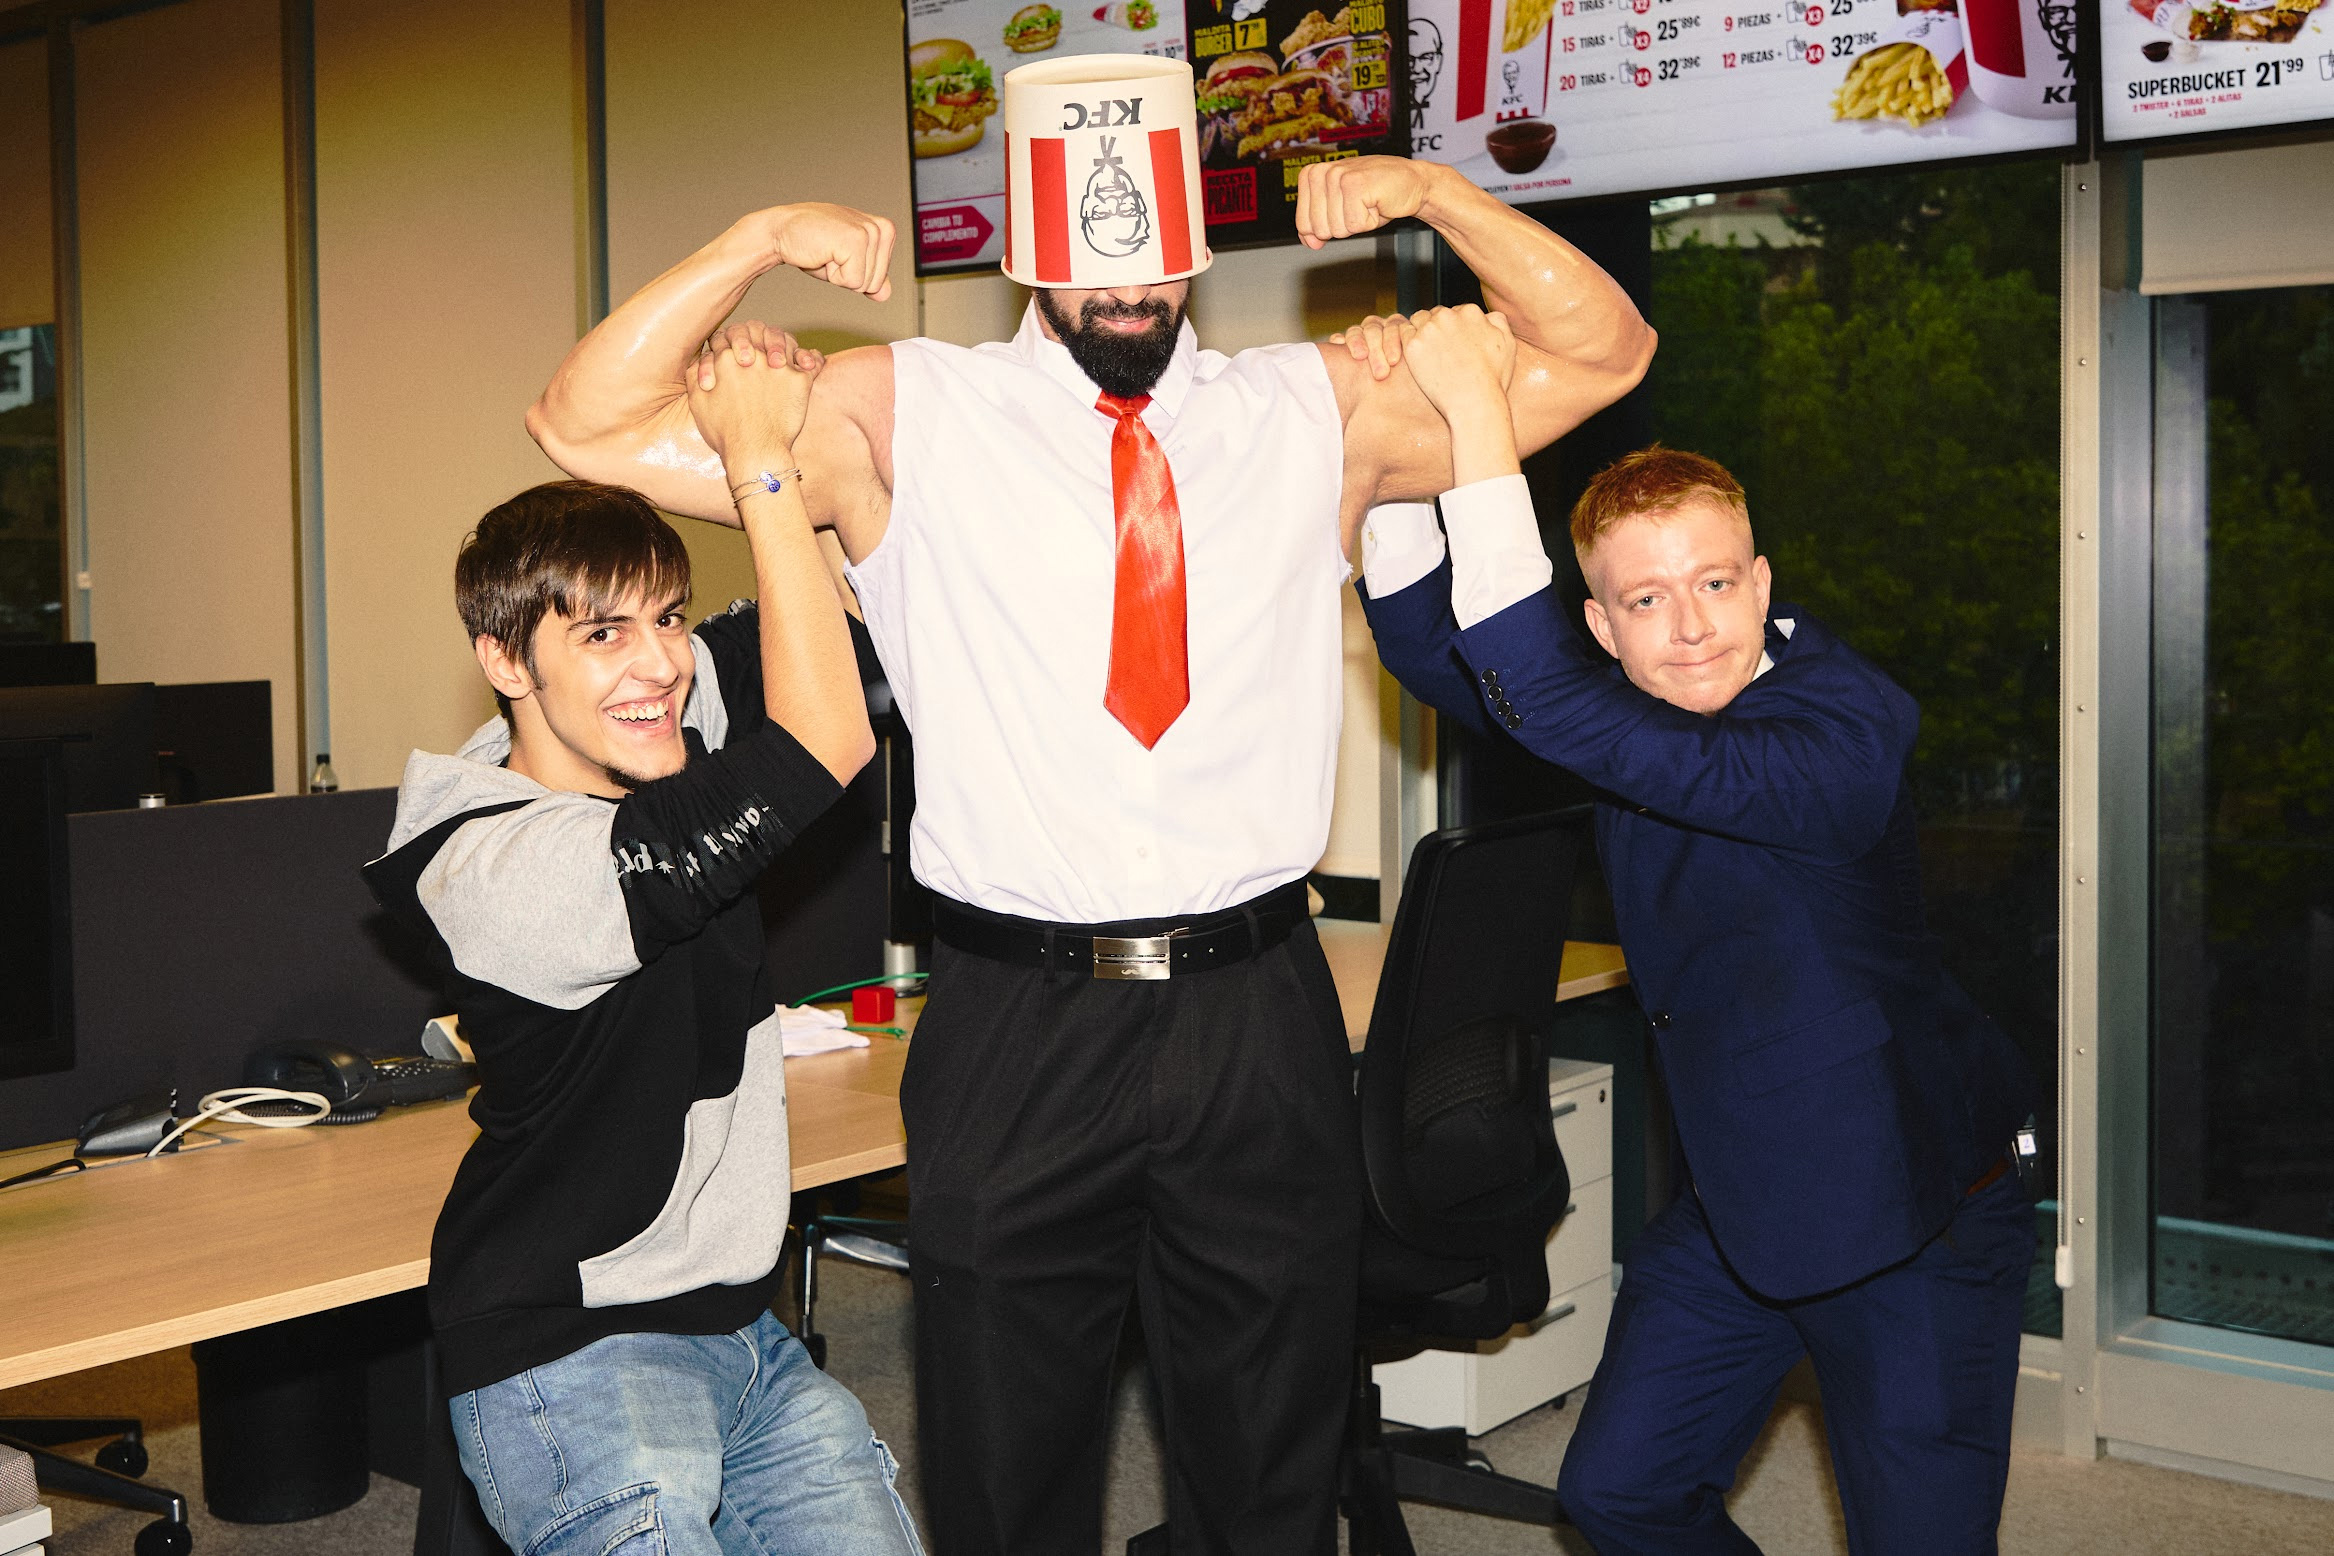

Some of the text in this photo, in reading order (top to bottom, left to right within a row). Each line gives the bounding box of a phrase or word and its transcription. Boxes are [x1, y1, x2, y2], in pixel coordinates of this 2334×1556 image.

[1562, 1, 1575, 16] 12
[1579, 0, 1604, 12] TIRAS
[1350, 4, 1385, 34] CUBO
[1724, 16, 1733, 31] 9
[1737, 13, 1771, 28] PIEZAS
[1562, 38, 1576, 53] 15
[1580, 36, 1605, 49] TIRAS
[1722, 52, 1737, 69] 12
[1740, 50, 1774, 65] PIEZAS
[1559, 75, 1576, 91] 20
[1580, 73, 1606, 87] TIRAS
[2128, 68, 2246, 99] SUPERBUCKET
[1501, 94, 1523, 105] KFC
[1063, 97, 1143, 130] KFC
[922, 226, 979, 244] COMPLEMENTO
